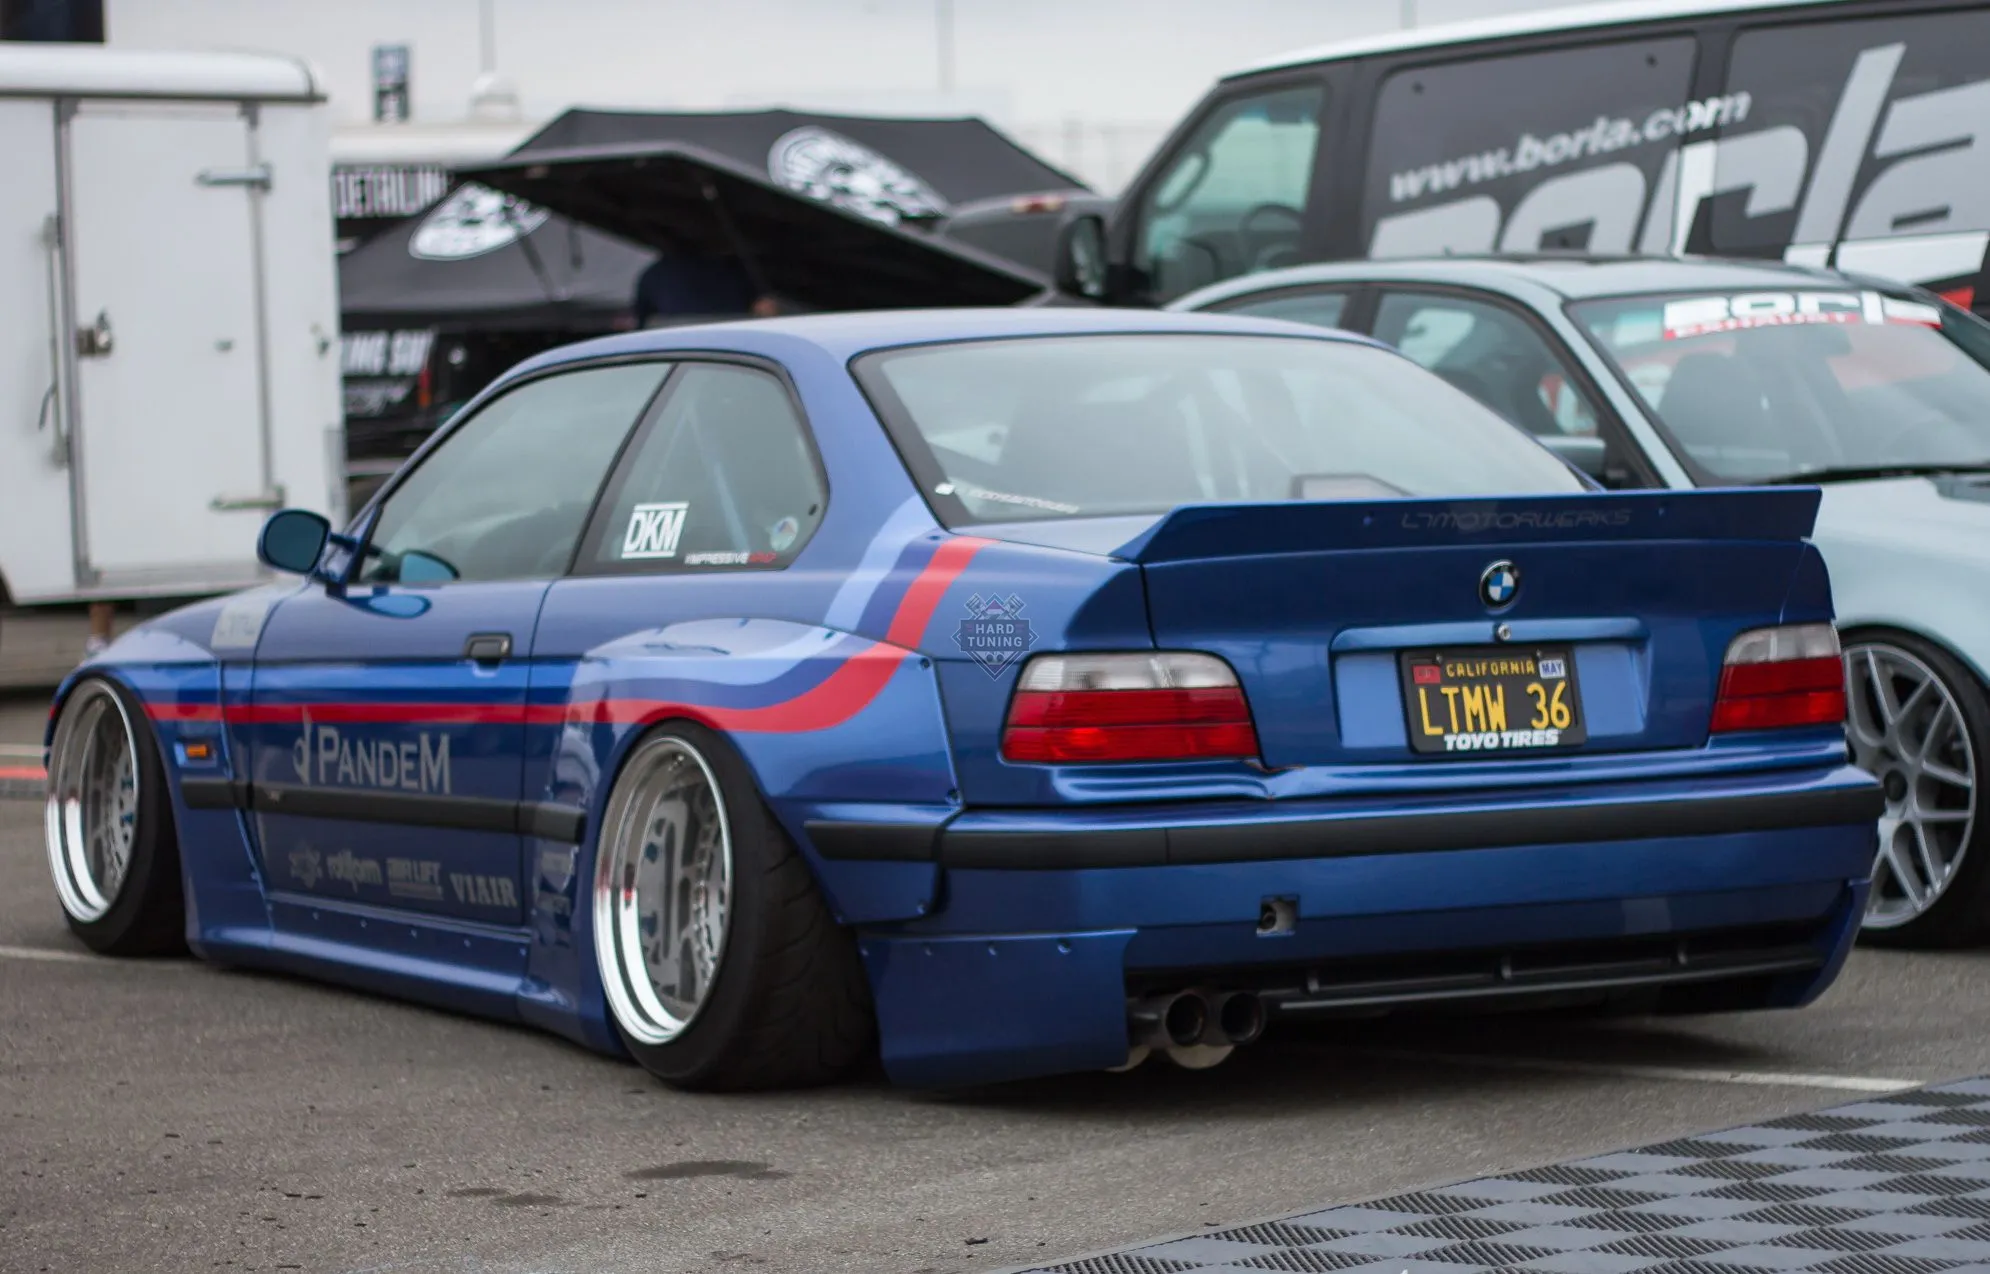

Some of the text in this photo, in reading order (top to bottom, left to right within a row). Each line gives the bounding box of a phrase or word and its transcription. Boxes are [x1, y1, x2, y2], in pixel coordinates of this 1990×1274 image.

[1389, 90, 1752, 202] www.borla.com
[623, 510, 688, 551] DKM
[1445, 659, 1536, 678] CALIFORNIA
[1541, 660, 1563, 675] MAY
[1418, 680, 1571, 736] LTMW 36
[1444, 728, 1560, 751] TOYO TIRES
[449, 872, 517, 907] VIAIR
